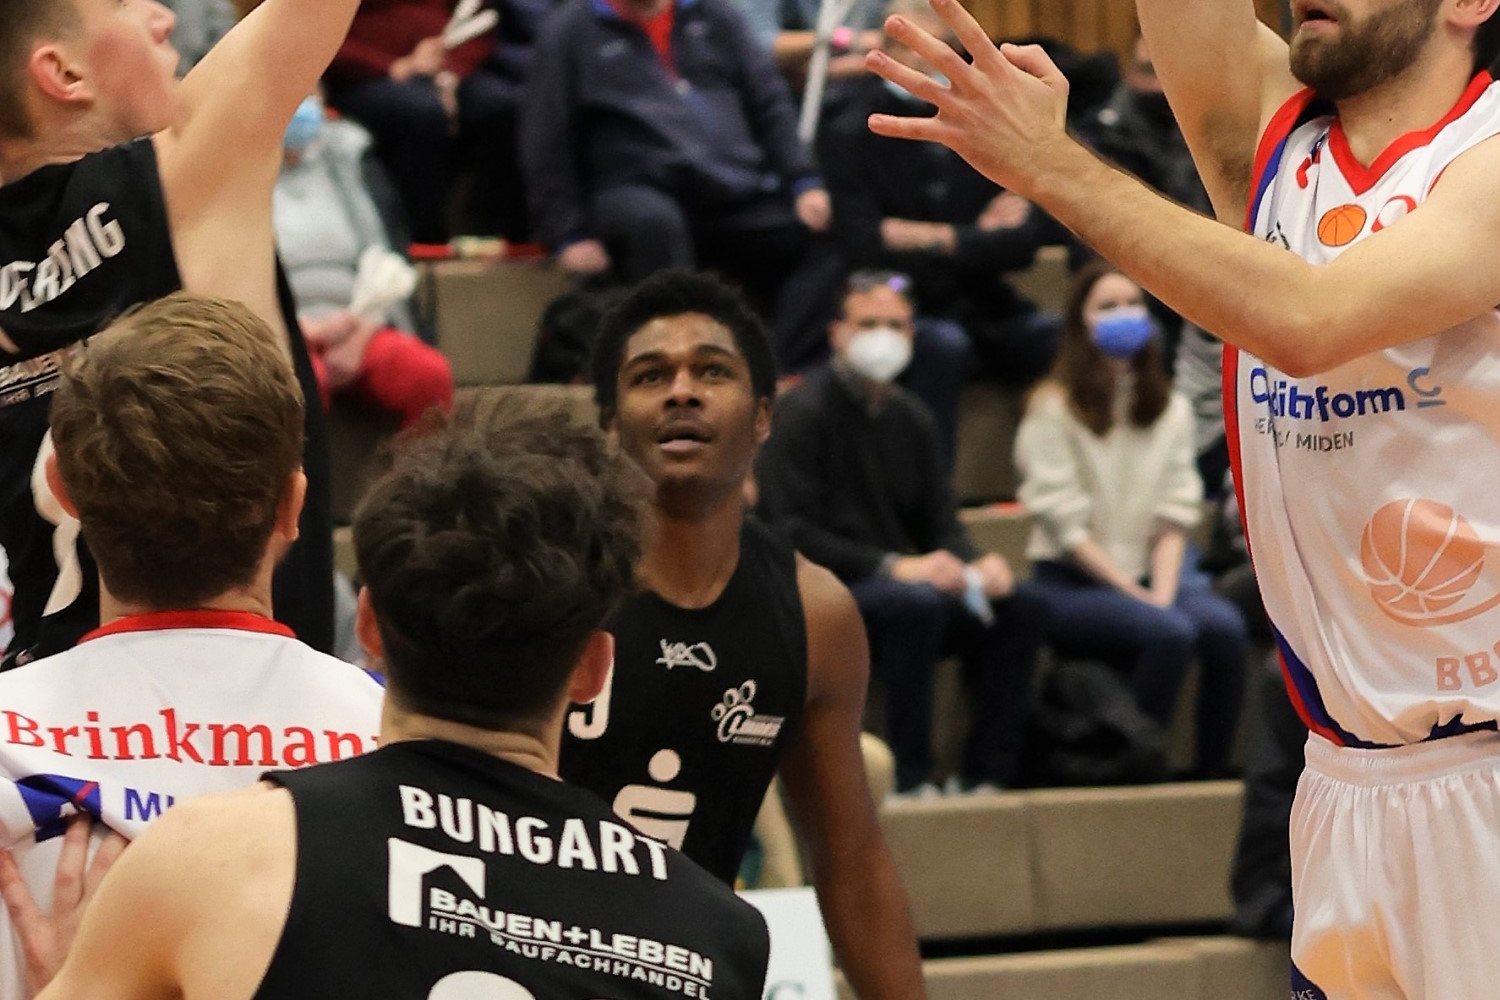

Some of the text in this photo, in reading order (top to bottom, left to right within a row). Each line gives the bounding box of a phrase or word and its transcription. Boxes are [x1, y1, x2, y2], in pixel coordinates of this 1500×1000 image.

[2, 707, 379, 768] Brinkman
[398, 785, 669, 881] BUNGART
[429, 915, 476, 938] IHR
[429, 887, 713, 981] BAUEN+LEBEN
